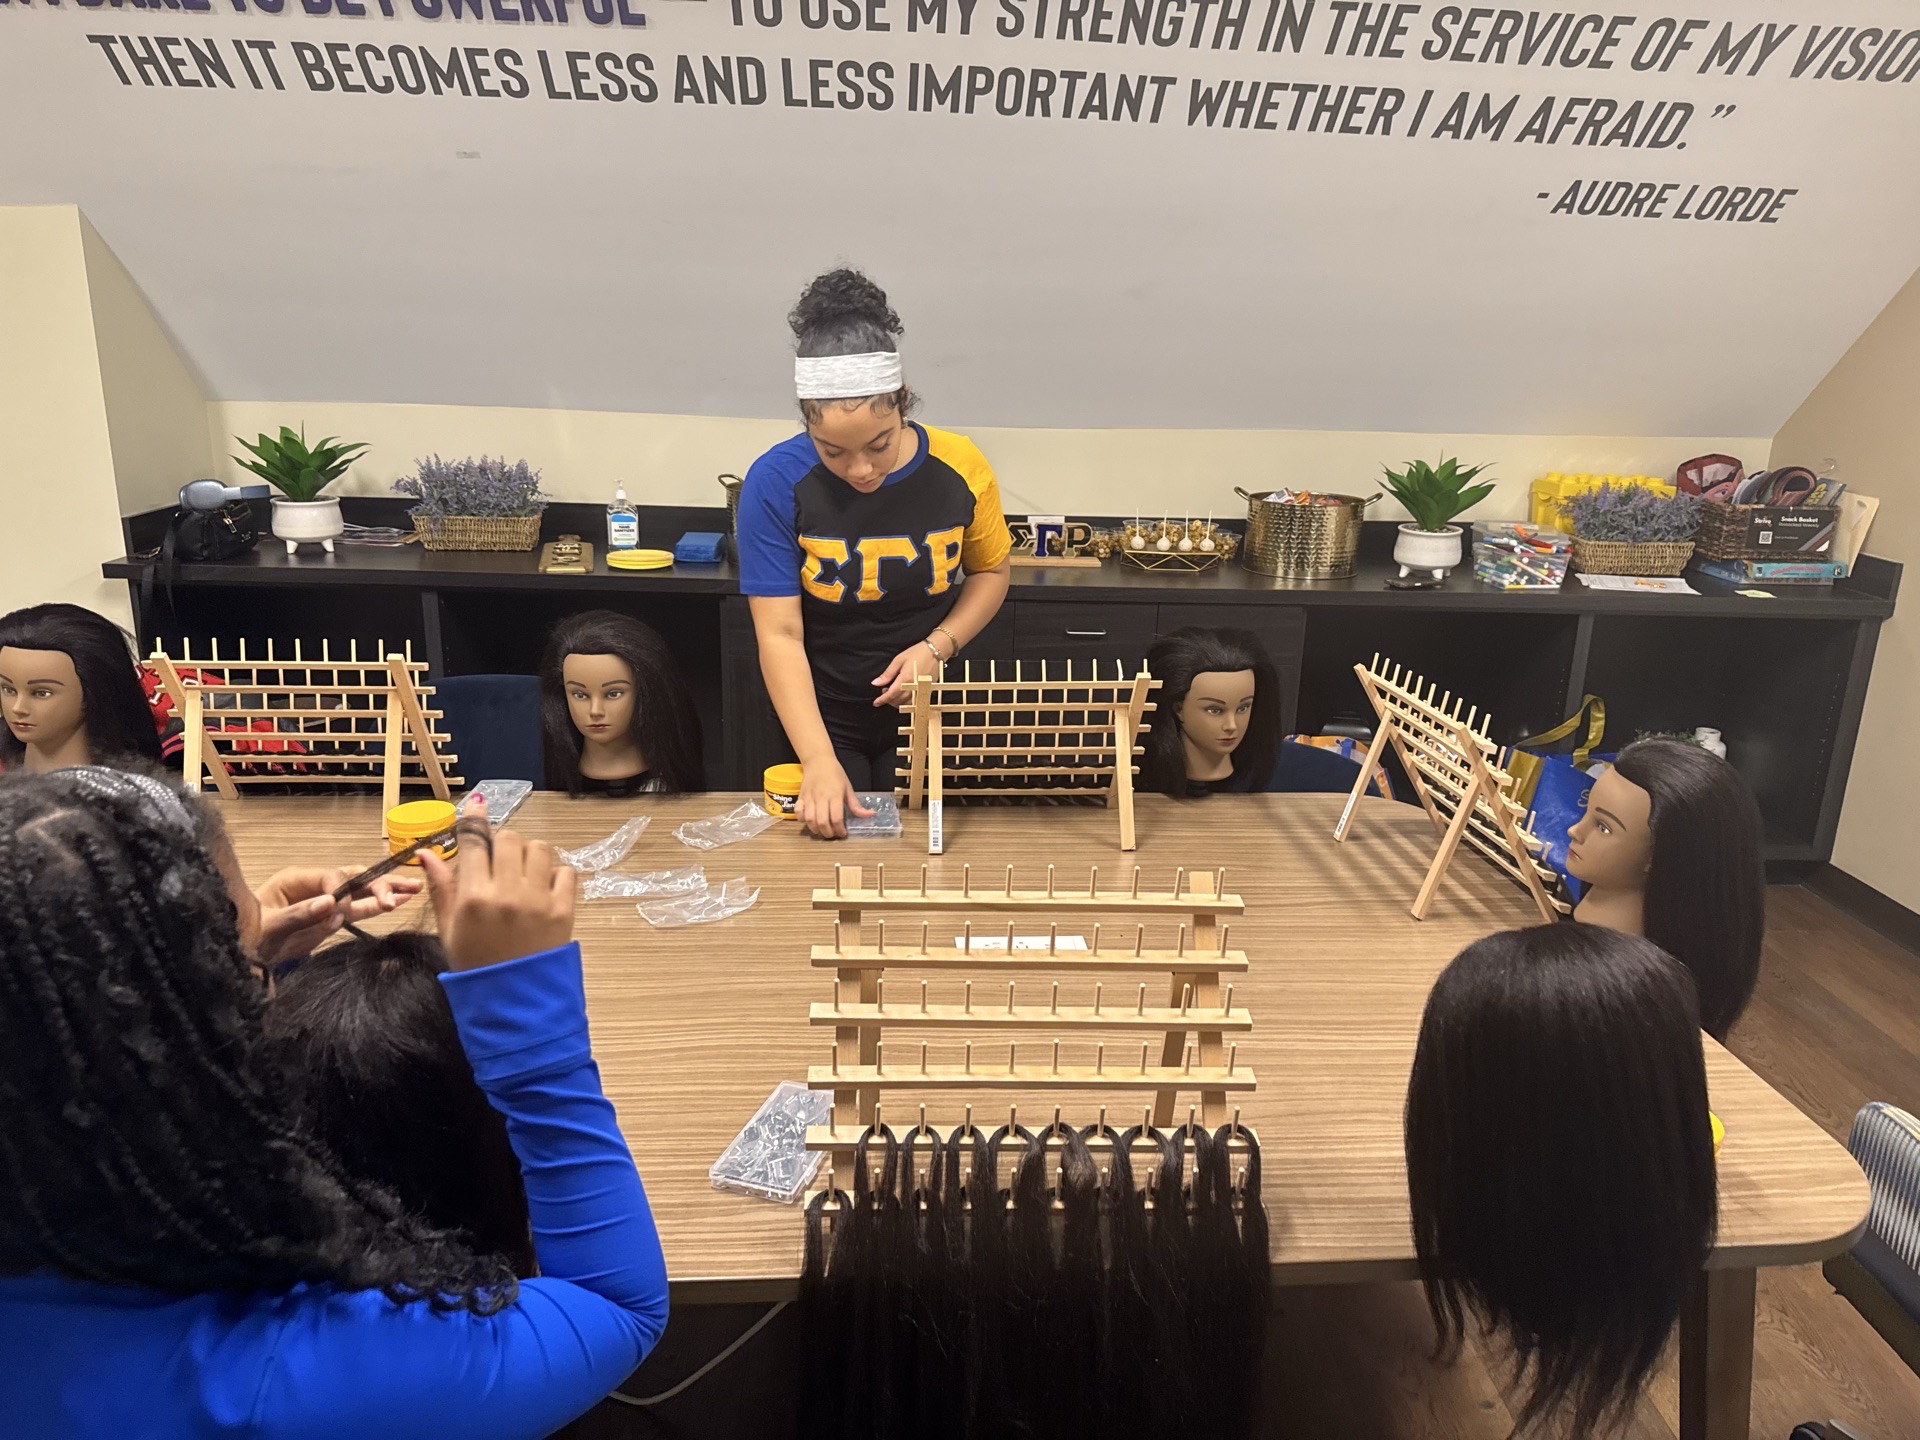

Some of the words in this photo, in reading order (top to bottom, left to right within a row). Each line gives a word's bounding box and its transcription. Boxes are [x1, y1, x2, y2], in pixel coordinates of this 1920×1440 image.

[996, 0, 1252, 51] STRENGTH
[1256, 0, 1316, 53] IN
[1325, 1, 1422, 59] THE
[1421, 6, 1636, 70] SERVICE
[1631, 18, 1711, 72] OF
[1696, 22, 1798, 77] MY
[1790, 26, 1920, 83] VISIO
[86, 35, 236, 88] THEN
[231, 39, 286, 91] IT
[290, 42, 530, 100] BECOMES
[536, 50, 658, 104] LESS
[674, 54, 767, 106] AND
[780, 58, 894, 111] LESS
[908, 63, 1178, 124] IMPORTANT
[1187, 79, 1406, 137] WHETHER
[1406, 90, 1434, 138] I
[1431, 92, 1520, 143] AM
[1673, 185, 1799, 224] LORDE
[772, 794, 793, 802] Shine
